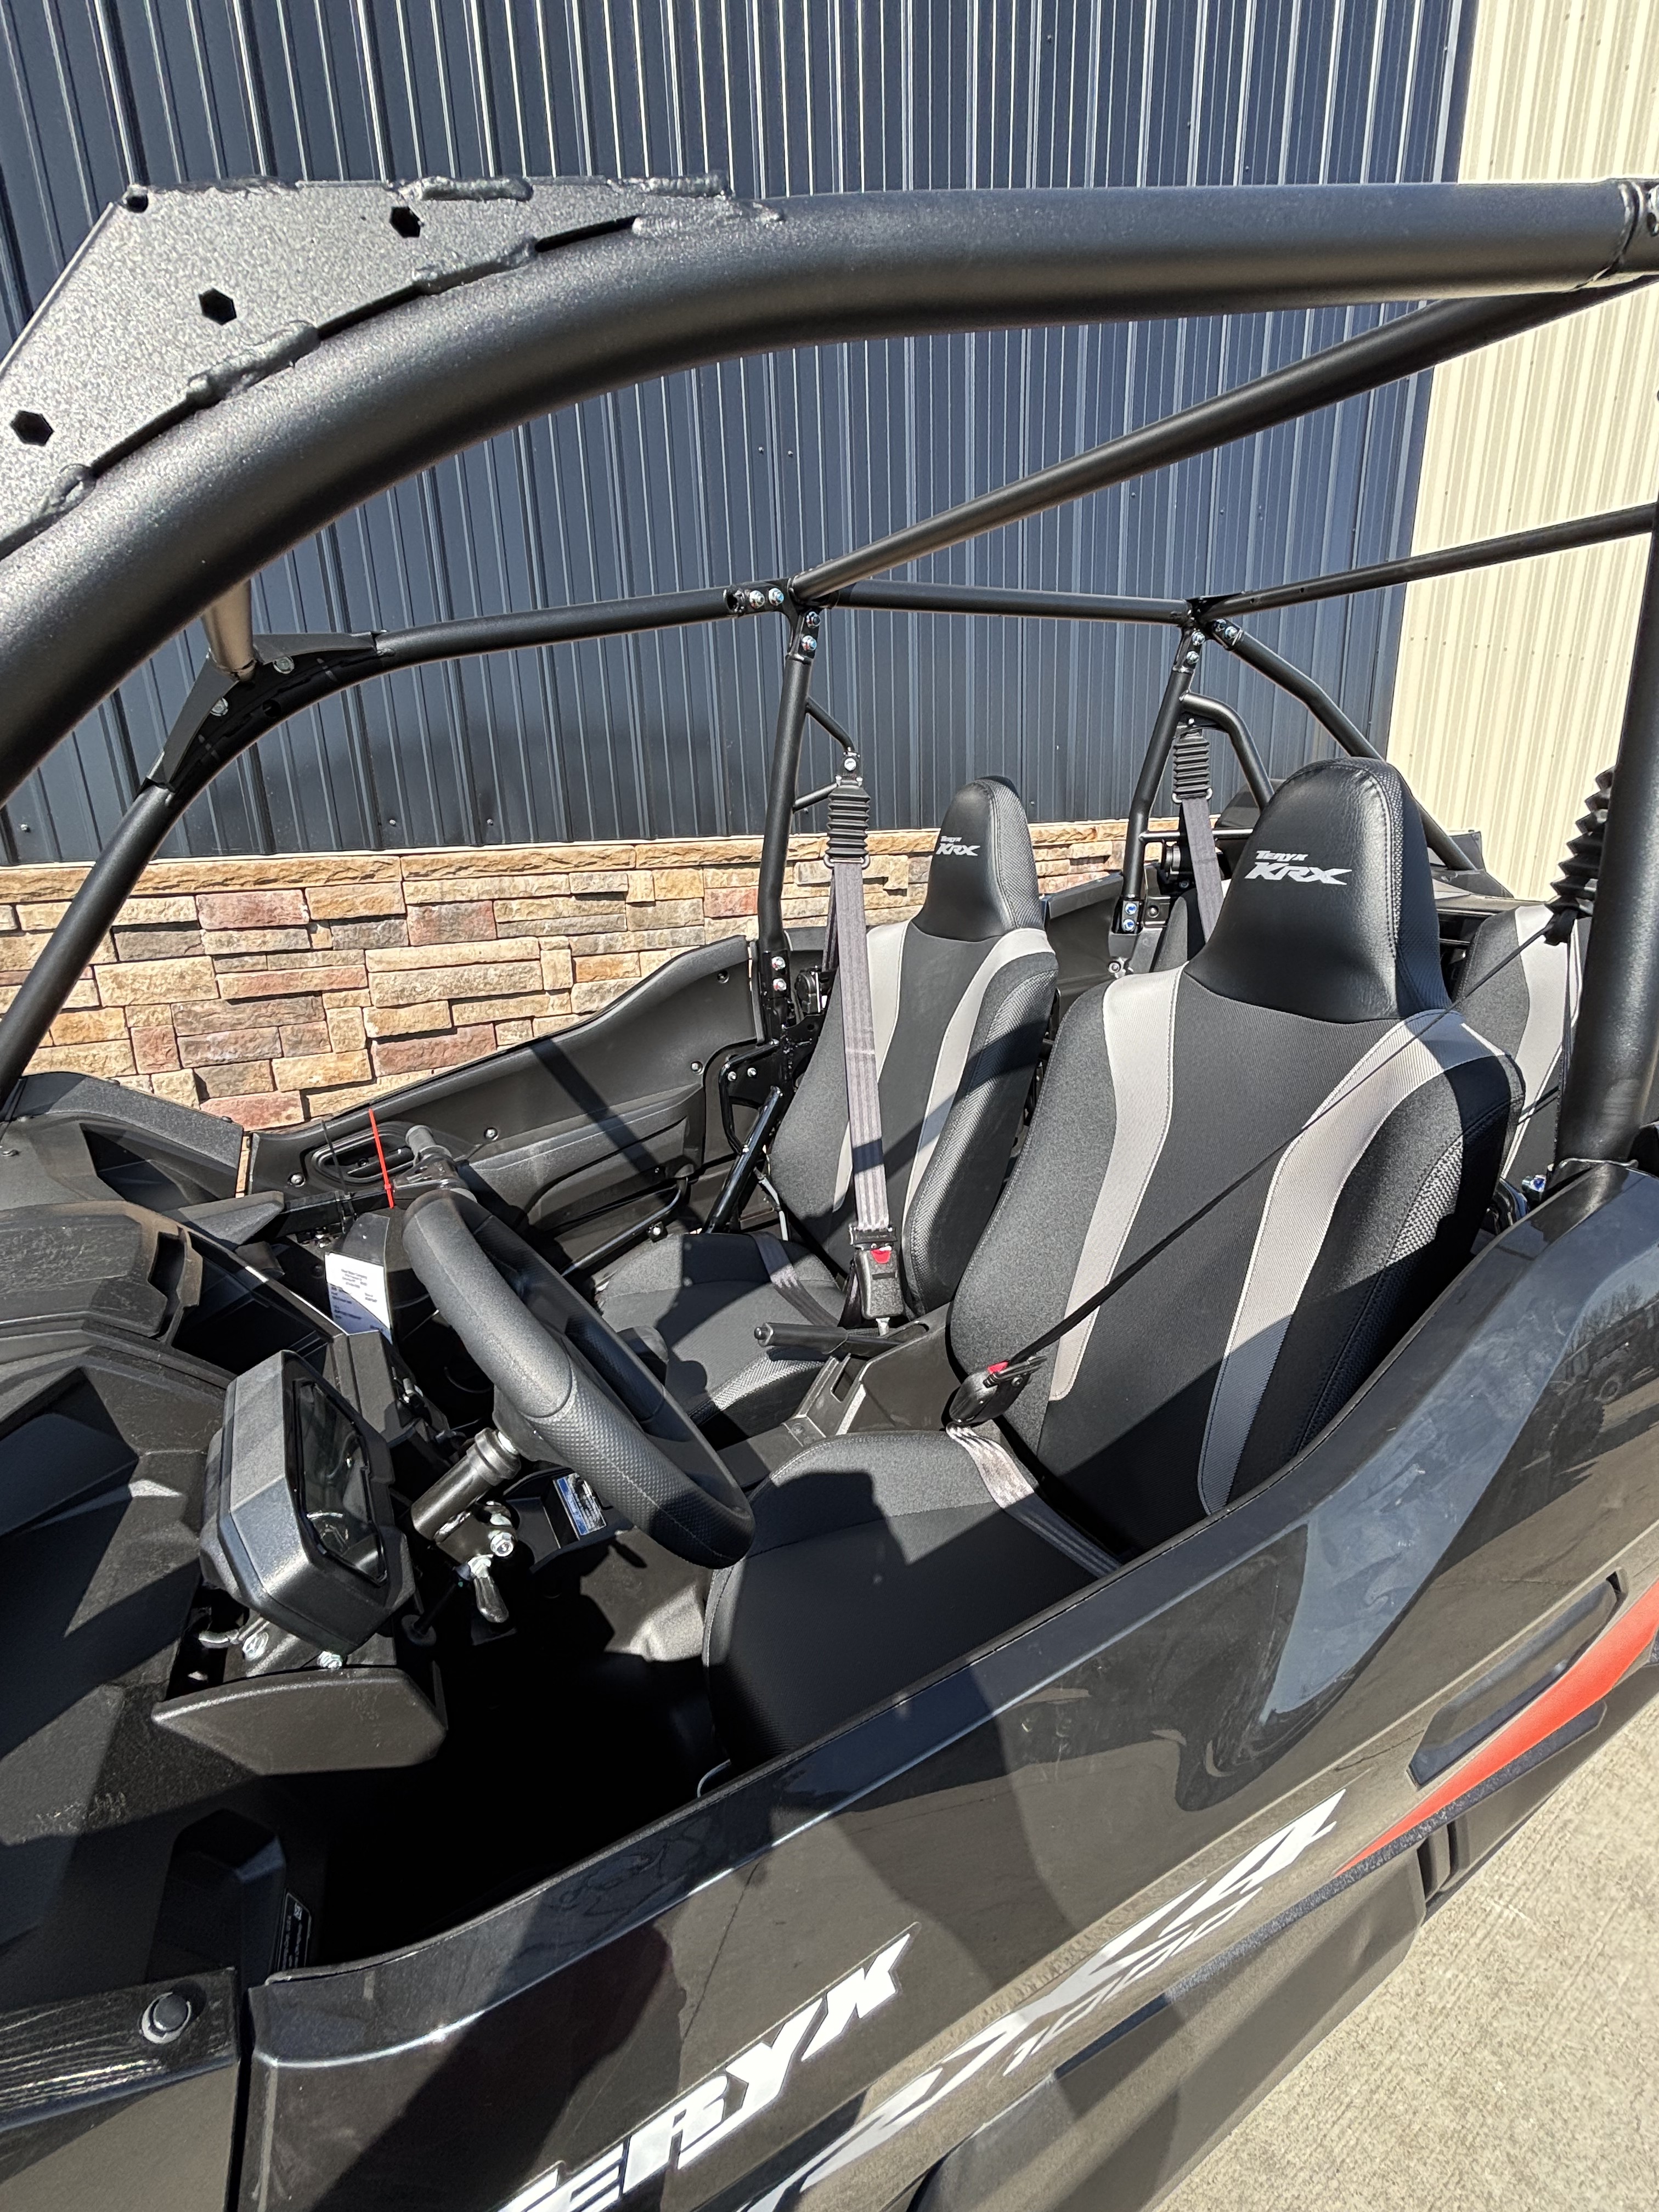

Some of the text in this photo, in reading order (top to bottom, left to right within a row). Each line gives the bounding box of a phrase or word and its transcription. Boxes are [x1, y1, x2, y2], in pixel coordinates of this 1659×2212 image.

[935, 843, 981, 856] KRX
[1244, 862, 1352, 885] KRX
[736, 1789, 1345, 2212] RX4
[1003, 1887, 1263, 2076] 1000
